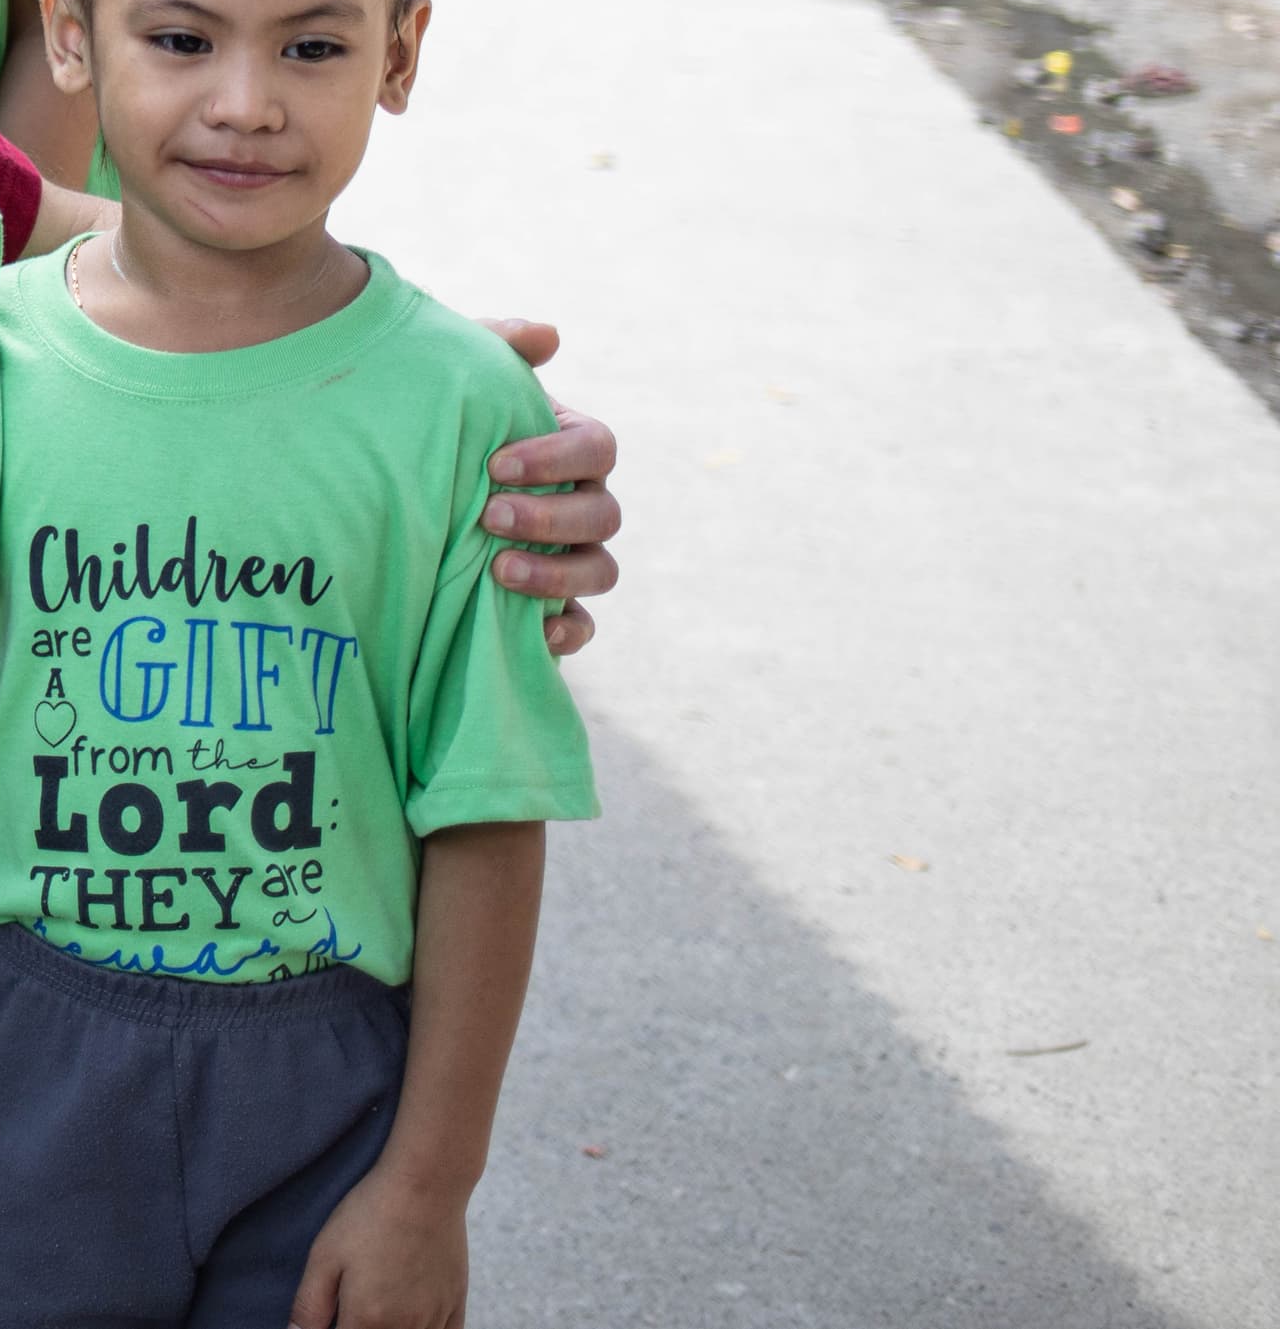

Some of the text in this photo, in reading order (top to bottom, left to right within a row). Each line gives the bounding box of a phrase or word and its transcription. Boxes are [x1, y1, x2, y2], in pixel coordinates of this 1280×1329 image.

[29, 516, 333, 613] Children
[31, 615, 358, 735] are A GIFT
[33, 750, 339, 856] Lord:
[70, 735, 279, 775] from the
[30, 859, 323, 931] THEY are a
